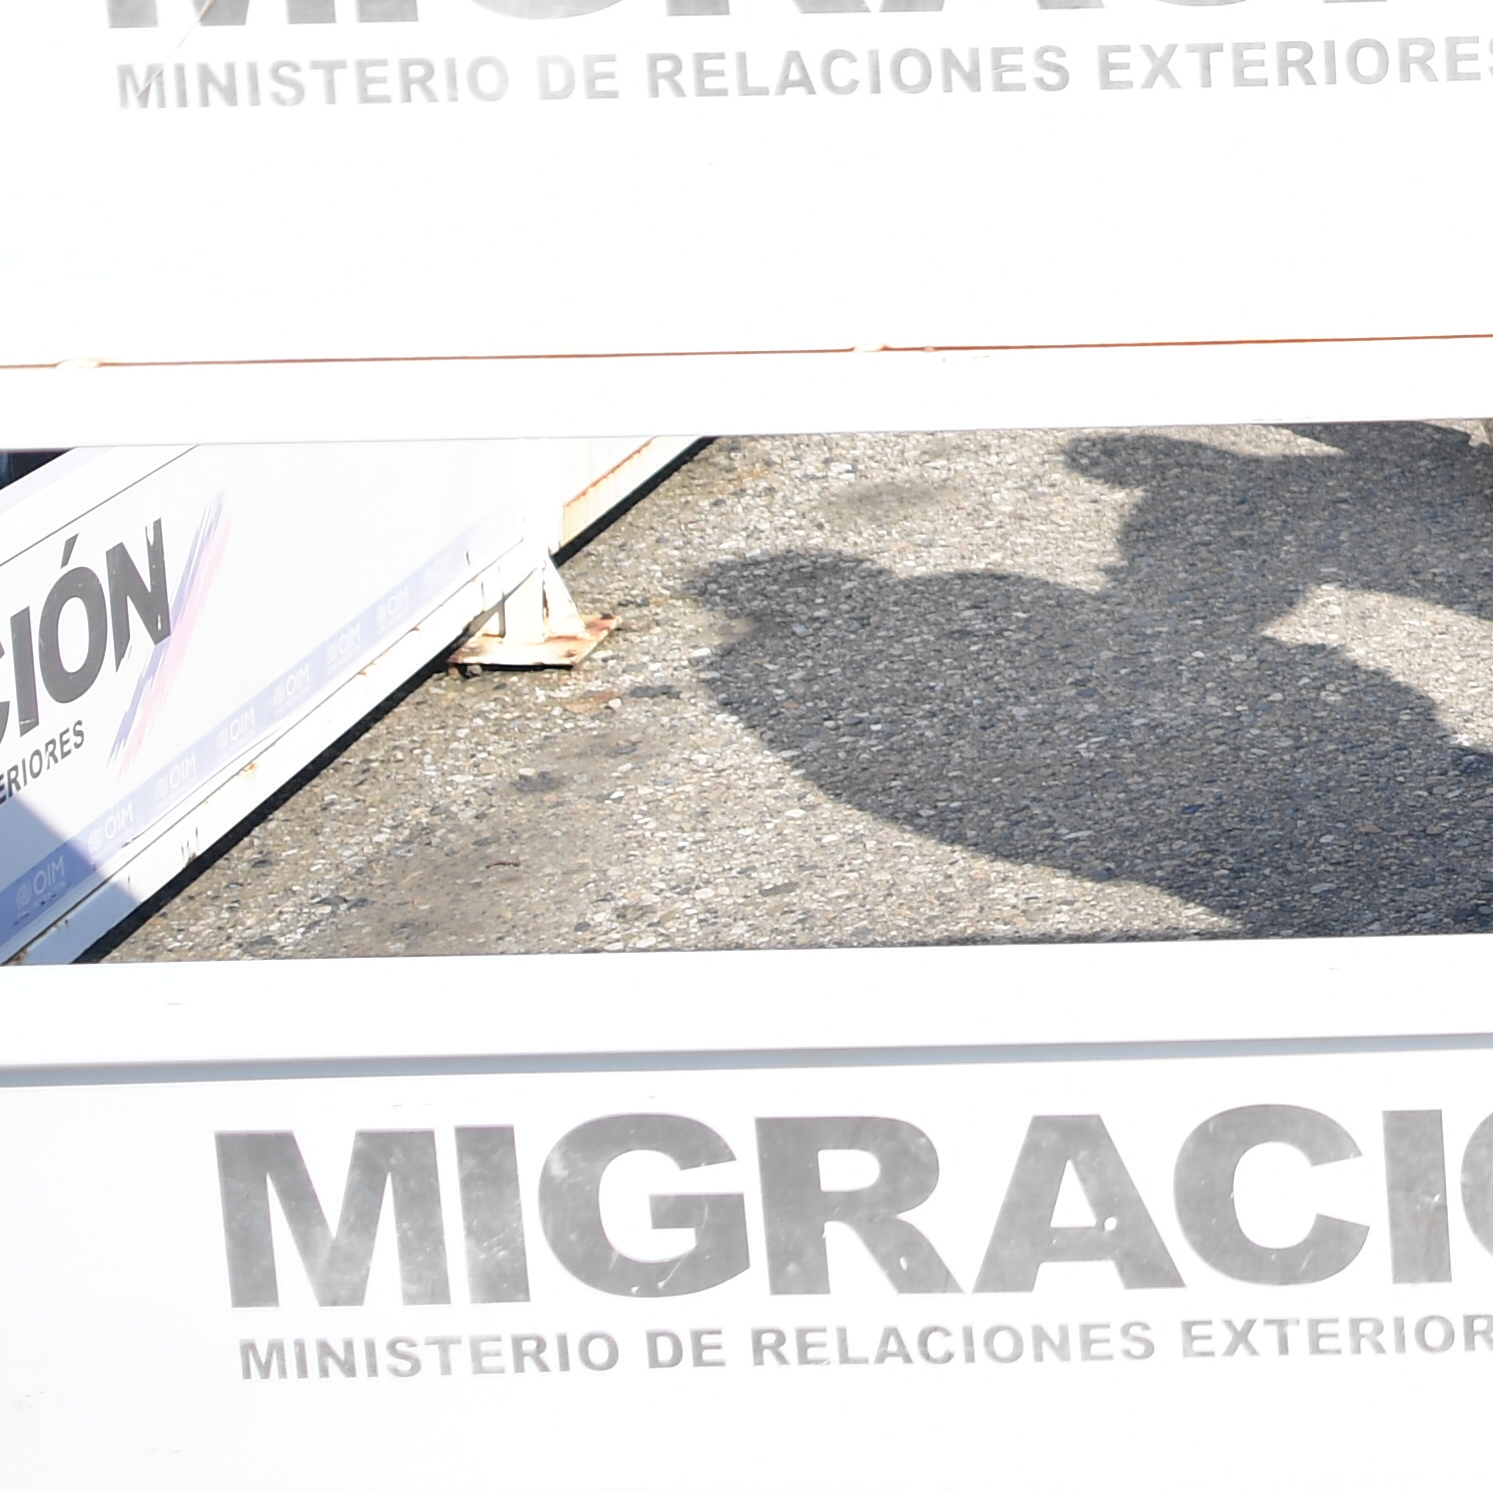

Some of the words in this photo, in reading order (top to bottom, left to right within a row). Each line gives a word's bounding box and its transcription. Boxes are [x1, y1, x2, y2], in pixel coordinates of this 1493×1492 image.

[116, 55, 509, 110] MINISTERIO
[537, 53, 619, 102] DE
[648, 44, 1071, 99] RELACIONES
[0, 517, 171, 745] IÓN
[104, 801, 133, 840] OIM
[33, 854, 65, 895] OIM
[239, 1330, 621, 1381] MINISTERIO
[647, 1328, 726, 1370] DE
[751, 1320, 1157, 1369] RELACIONES
